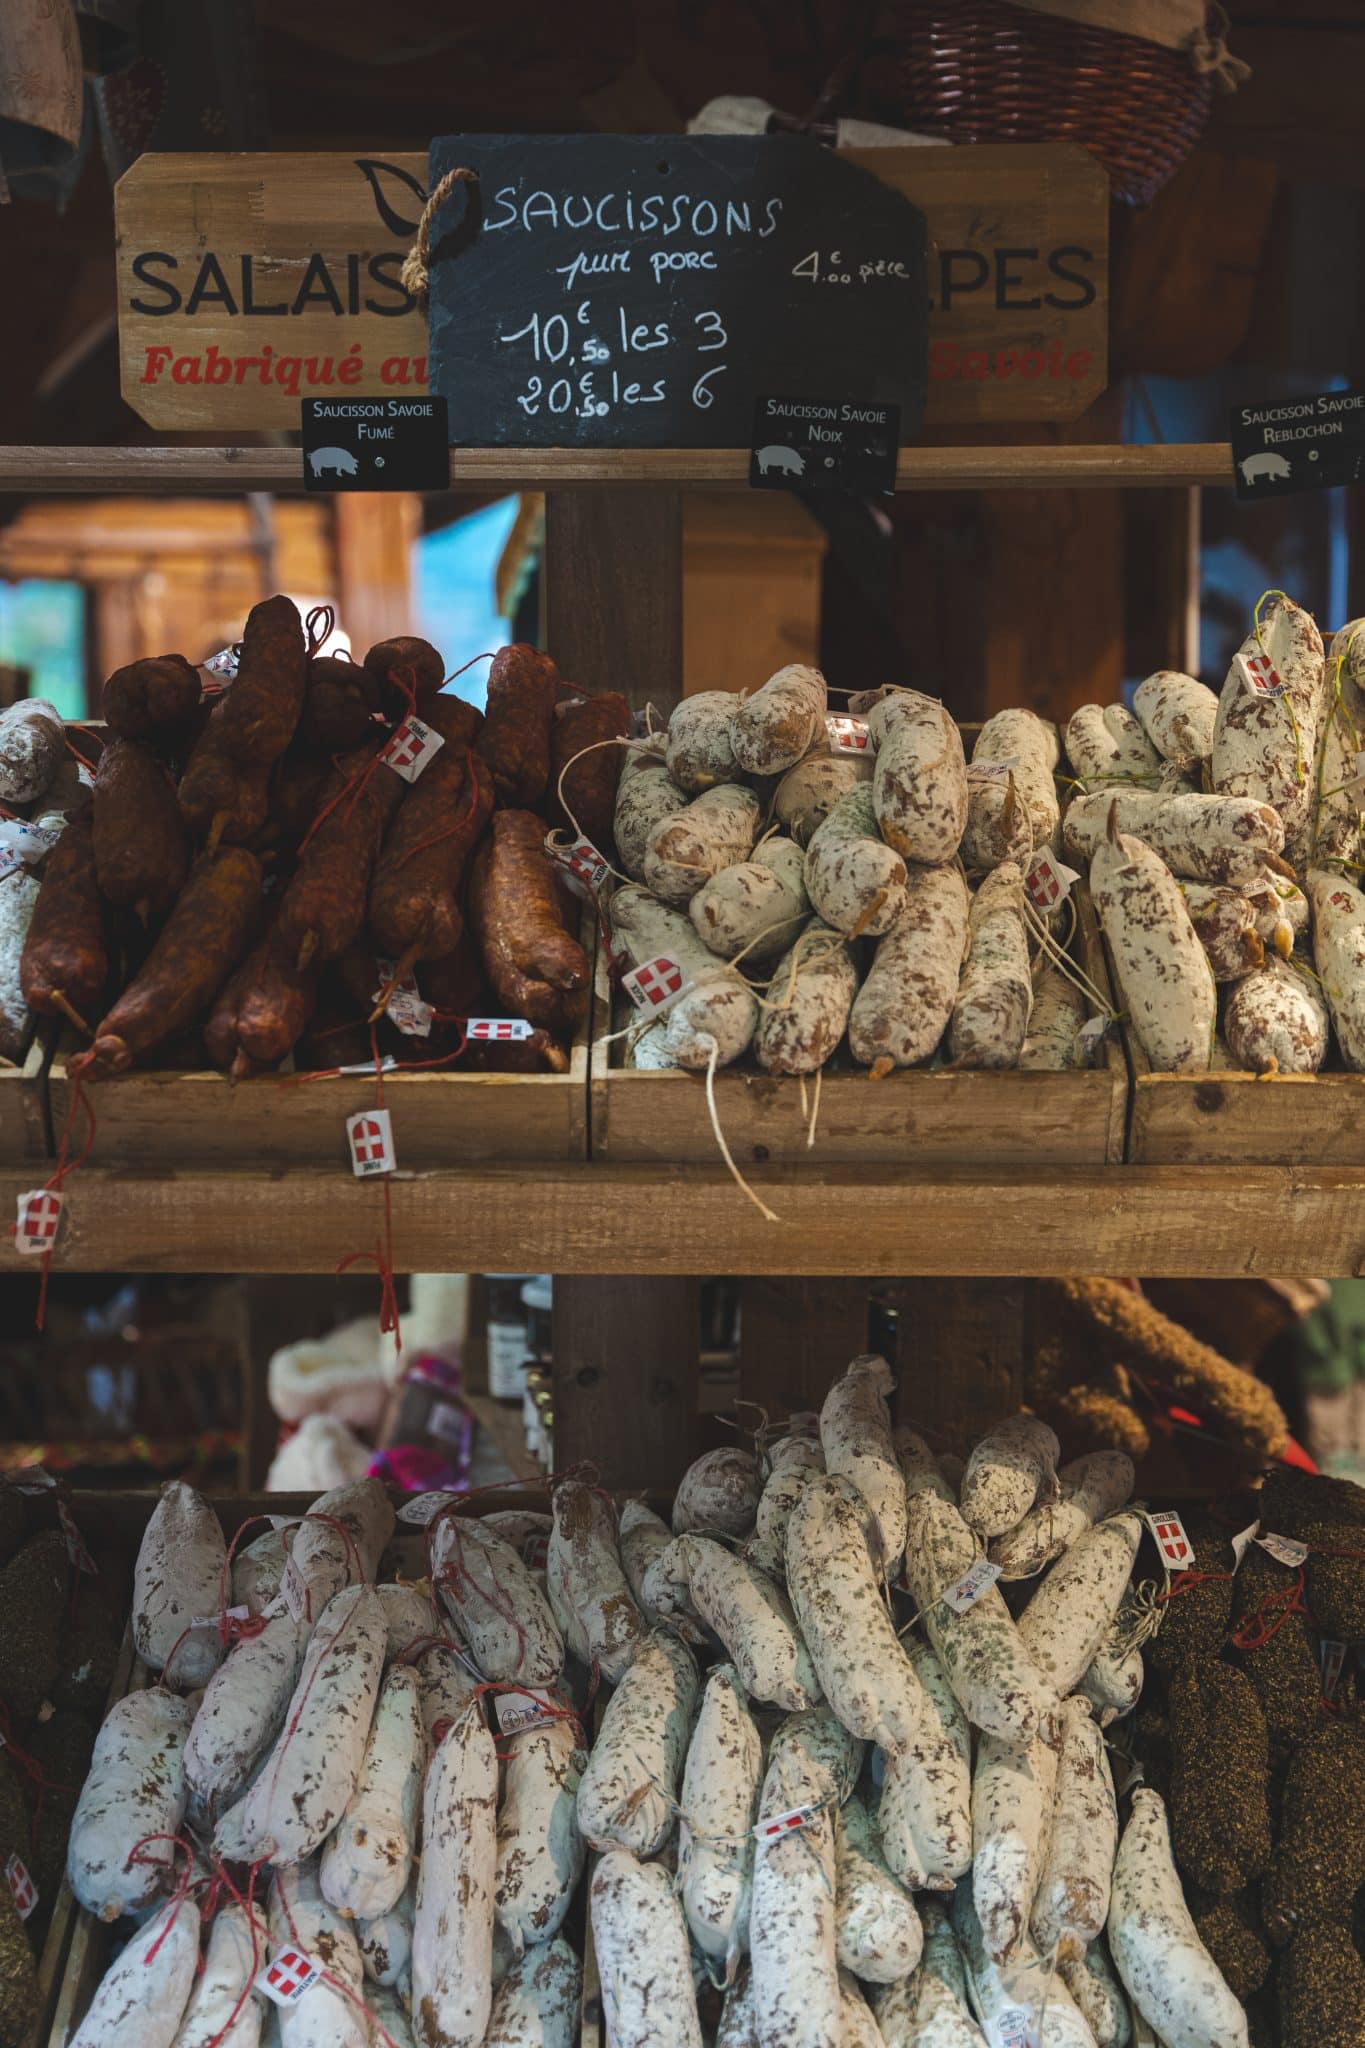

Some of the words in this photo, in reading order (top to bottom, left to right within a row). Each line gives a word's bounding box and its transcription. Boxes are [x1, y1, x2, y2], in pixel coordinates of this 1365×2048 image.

[929, 246, 1097, 312] PES
[619, 306, 669, 353] les
[695, 311, 728, 350] 3
[139, 343, 364, 396] Fabriqué
[612, 370, 666, 404] les
[692, 365, 728, 409] 6
